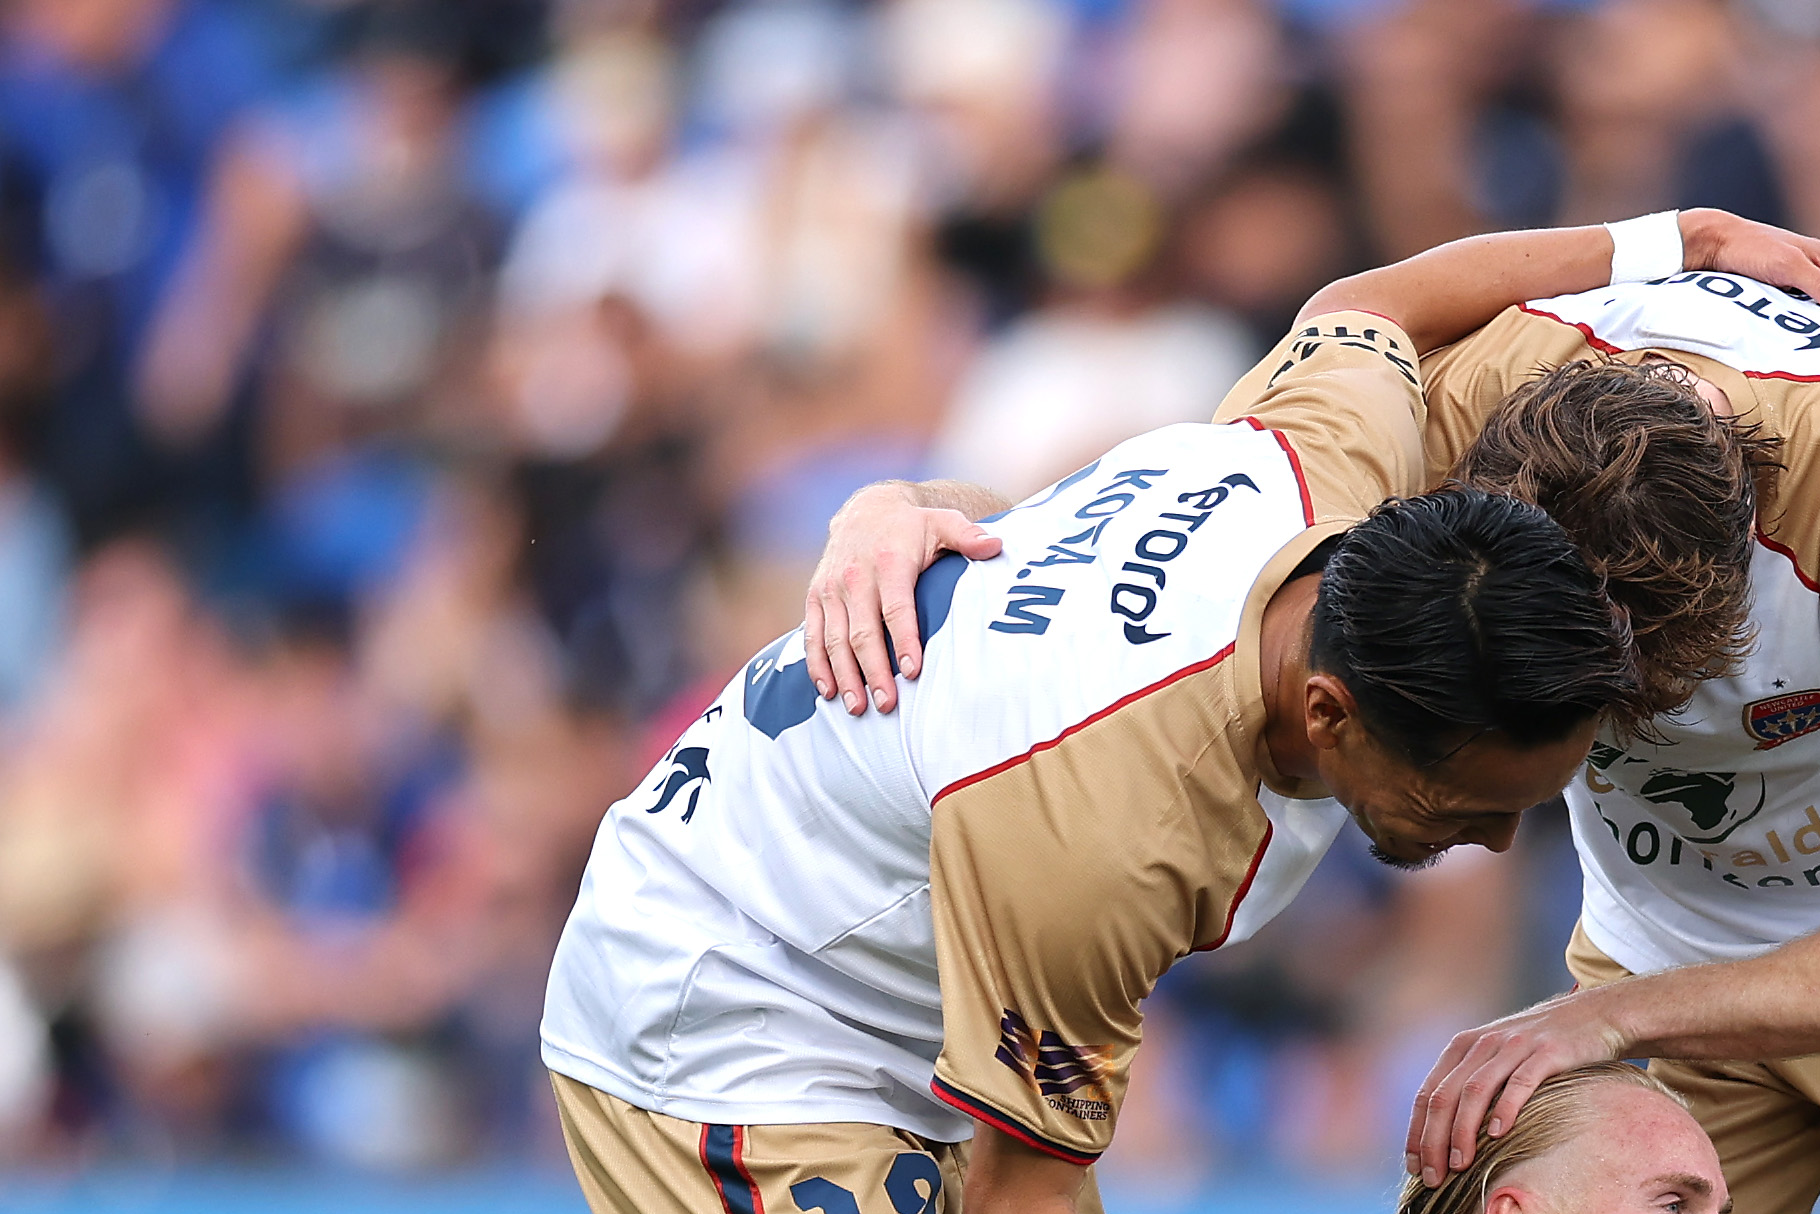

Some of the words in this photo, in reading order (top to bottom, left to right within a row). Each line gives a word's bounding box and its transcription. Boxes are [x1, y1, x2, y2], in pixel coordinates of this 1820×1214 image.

[988, 469, 1170, 636] KOTA.M
[1045, 1097, 1108, 1120] ONTAINERS
[1060, 1095, 1110, 1111] SHIPPING
